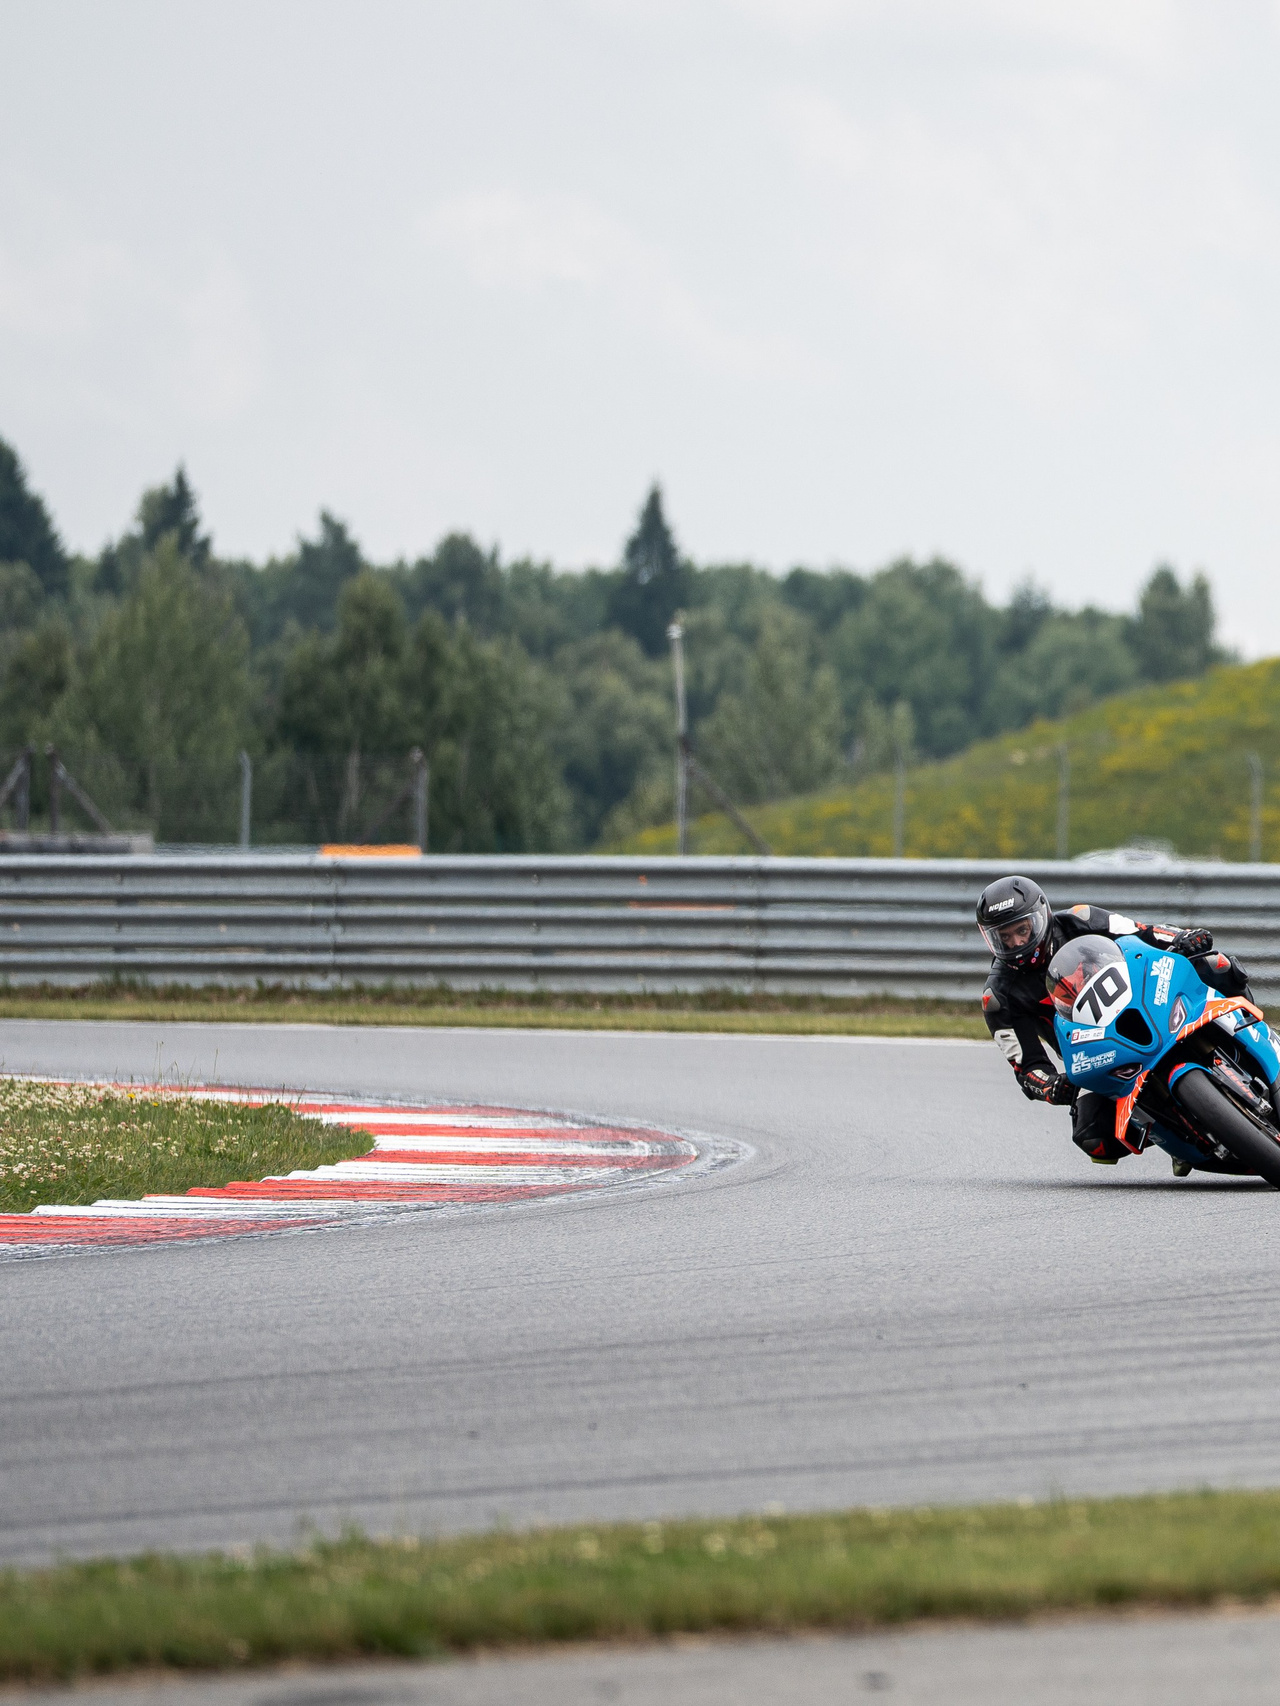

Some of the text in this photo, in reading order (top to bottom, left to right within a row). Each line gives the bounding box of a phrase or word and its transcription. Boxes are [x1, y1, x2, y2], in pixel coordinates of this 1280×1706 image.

[989, 898, 1014, 912] NOLAN
[1076, 966, 1128, 1025] 70
[1072, 1051, 1088, 1062] VL
[1090, 1050, 1116, 1063] RACING
[1071, 1060, 1092, 1075] 65
[1093, 1058, 1114, 1069] TEAM
